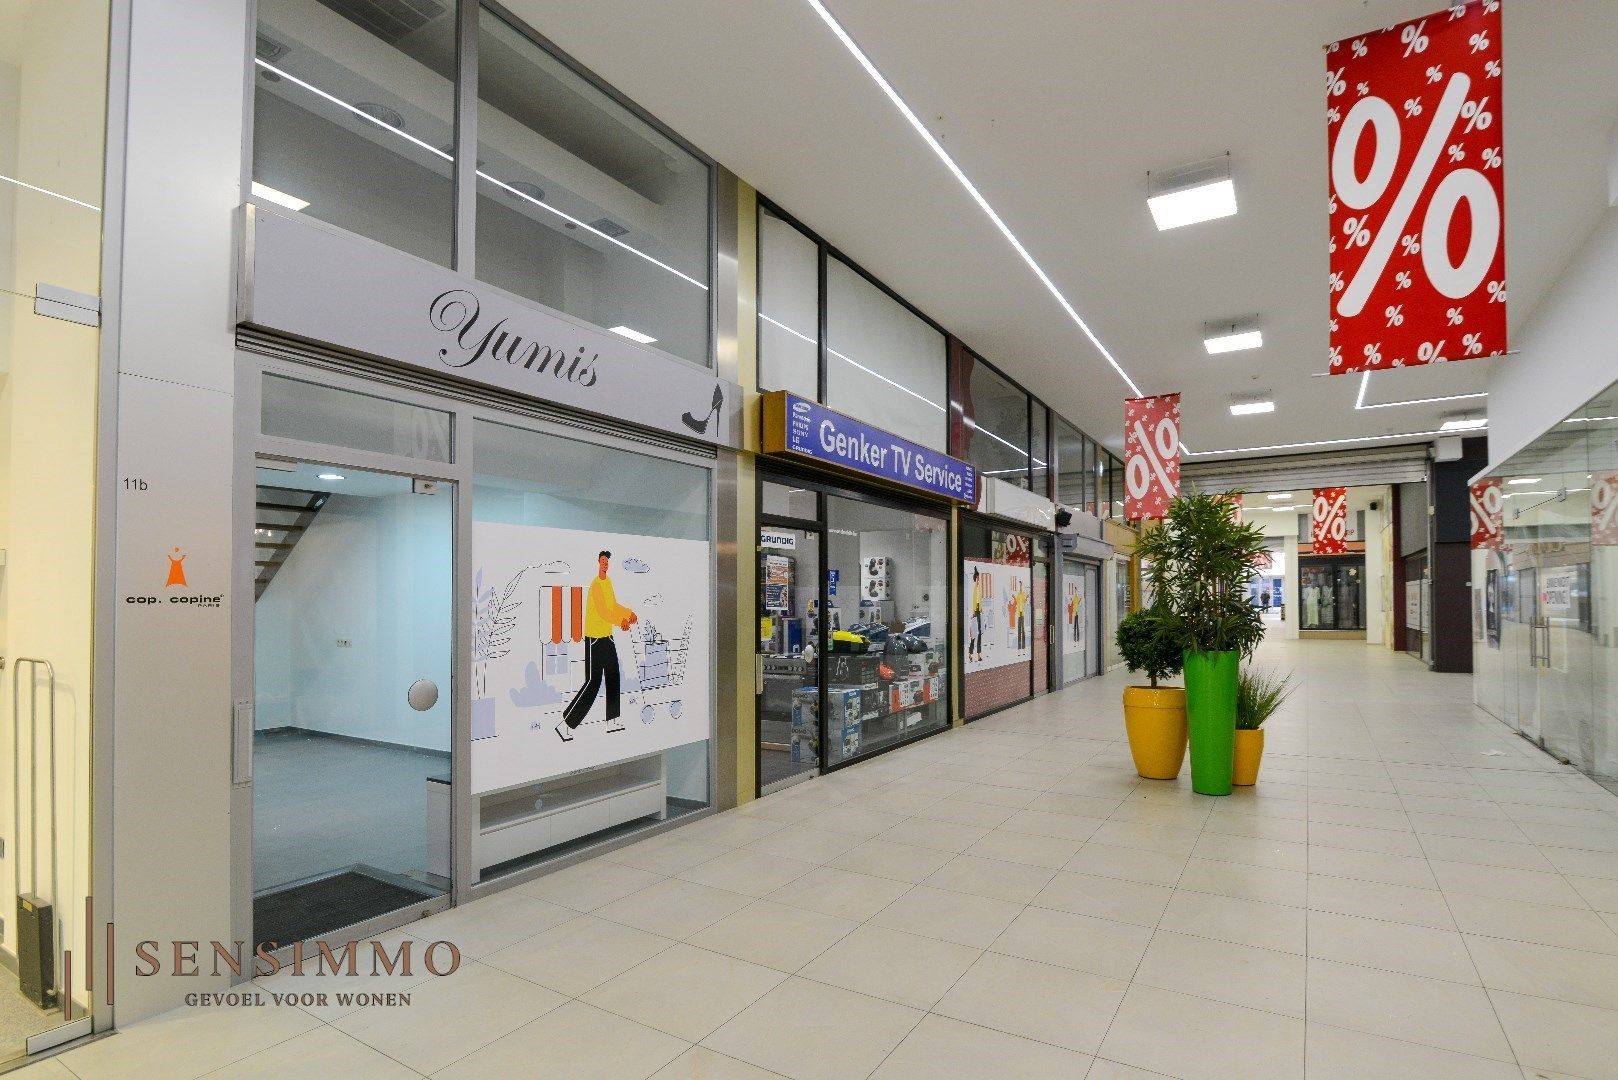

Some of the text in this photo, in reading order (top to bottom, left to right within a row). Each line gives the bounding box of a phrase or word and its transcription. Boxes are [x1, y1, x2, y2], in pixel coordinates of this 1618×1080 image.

[1332, 72, 1500, 317] %
[792, 435, 800, 444] LG
[819, 419, 887, 469] Genker
[891, 444, 912, 477] TV
[914, 453, 962, 493] Service
[124, 478, 148, 491] 11b
[761, 535, 794, 545] GRUNDIG
[126, 595, 221, 605] cop. copine
